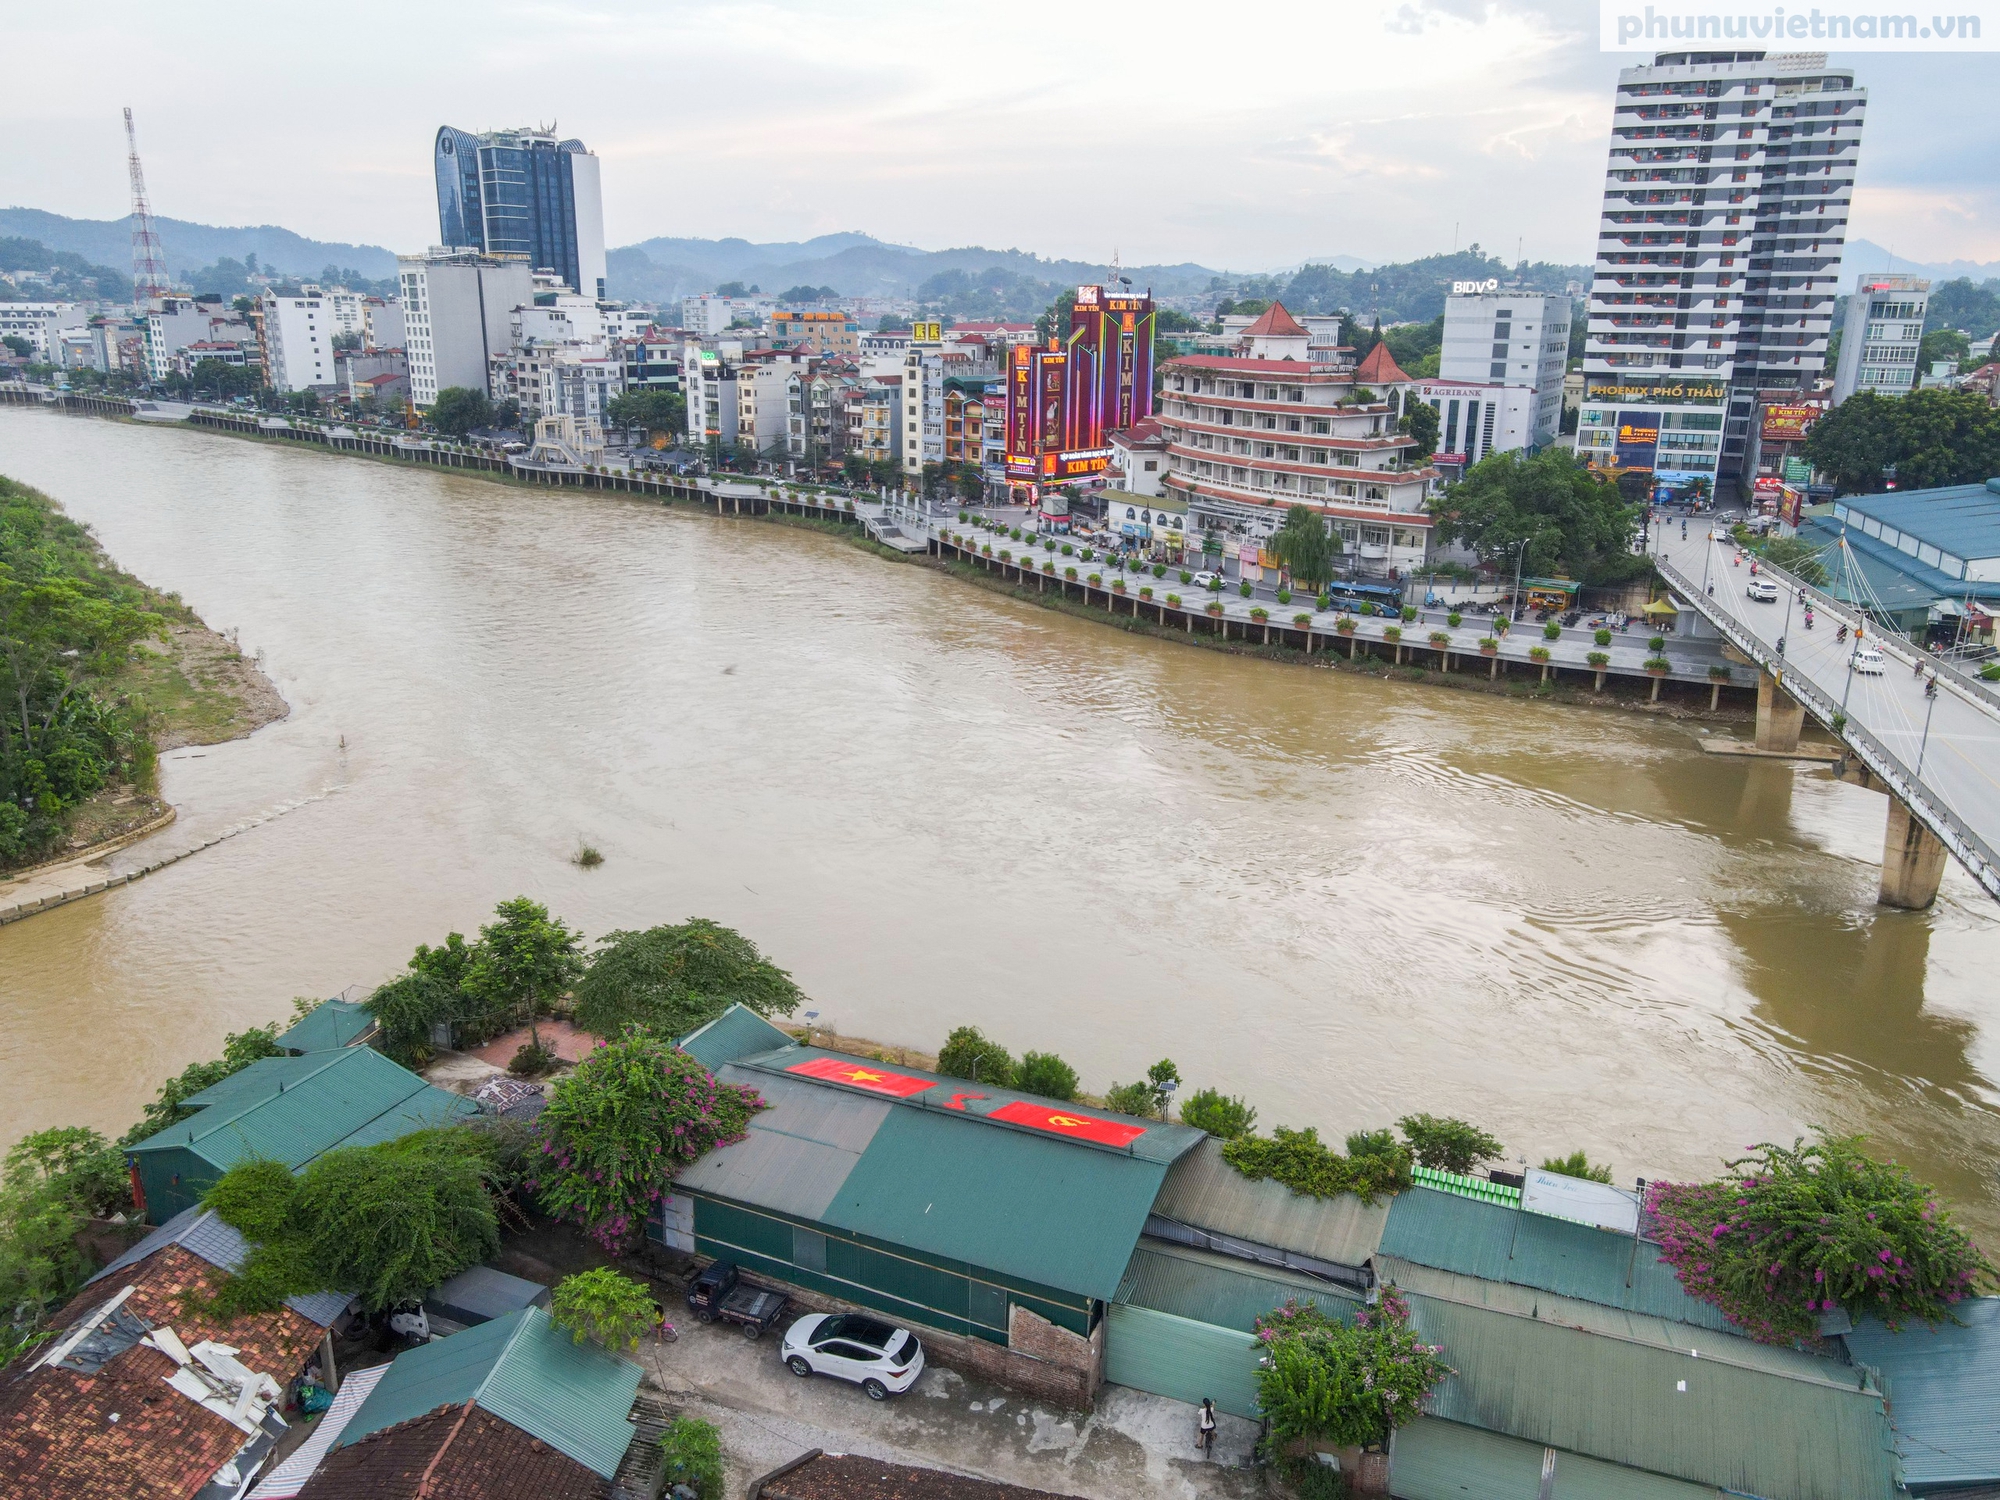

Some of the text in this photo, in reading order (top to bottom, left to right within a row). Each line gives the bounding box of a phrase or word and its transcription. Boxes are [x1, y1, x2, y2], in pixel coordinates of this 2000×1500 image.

[1454, 281, 1487, 293] BIDV
[1109, 298, 1142, 310] KIM TÍN
[702, 352, 715, 360] ECO
[1433, 388, 1482, 397] AGRIBANK
[1590, 386, 1648, 395] PHOENIX
[1652, 384, 1683, 397] PHỐ
[1067, 456, 1108, 473] KIM TÍN
